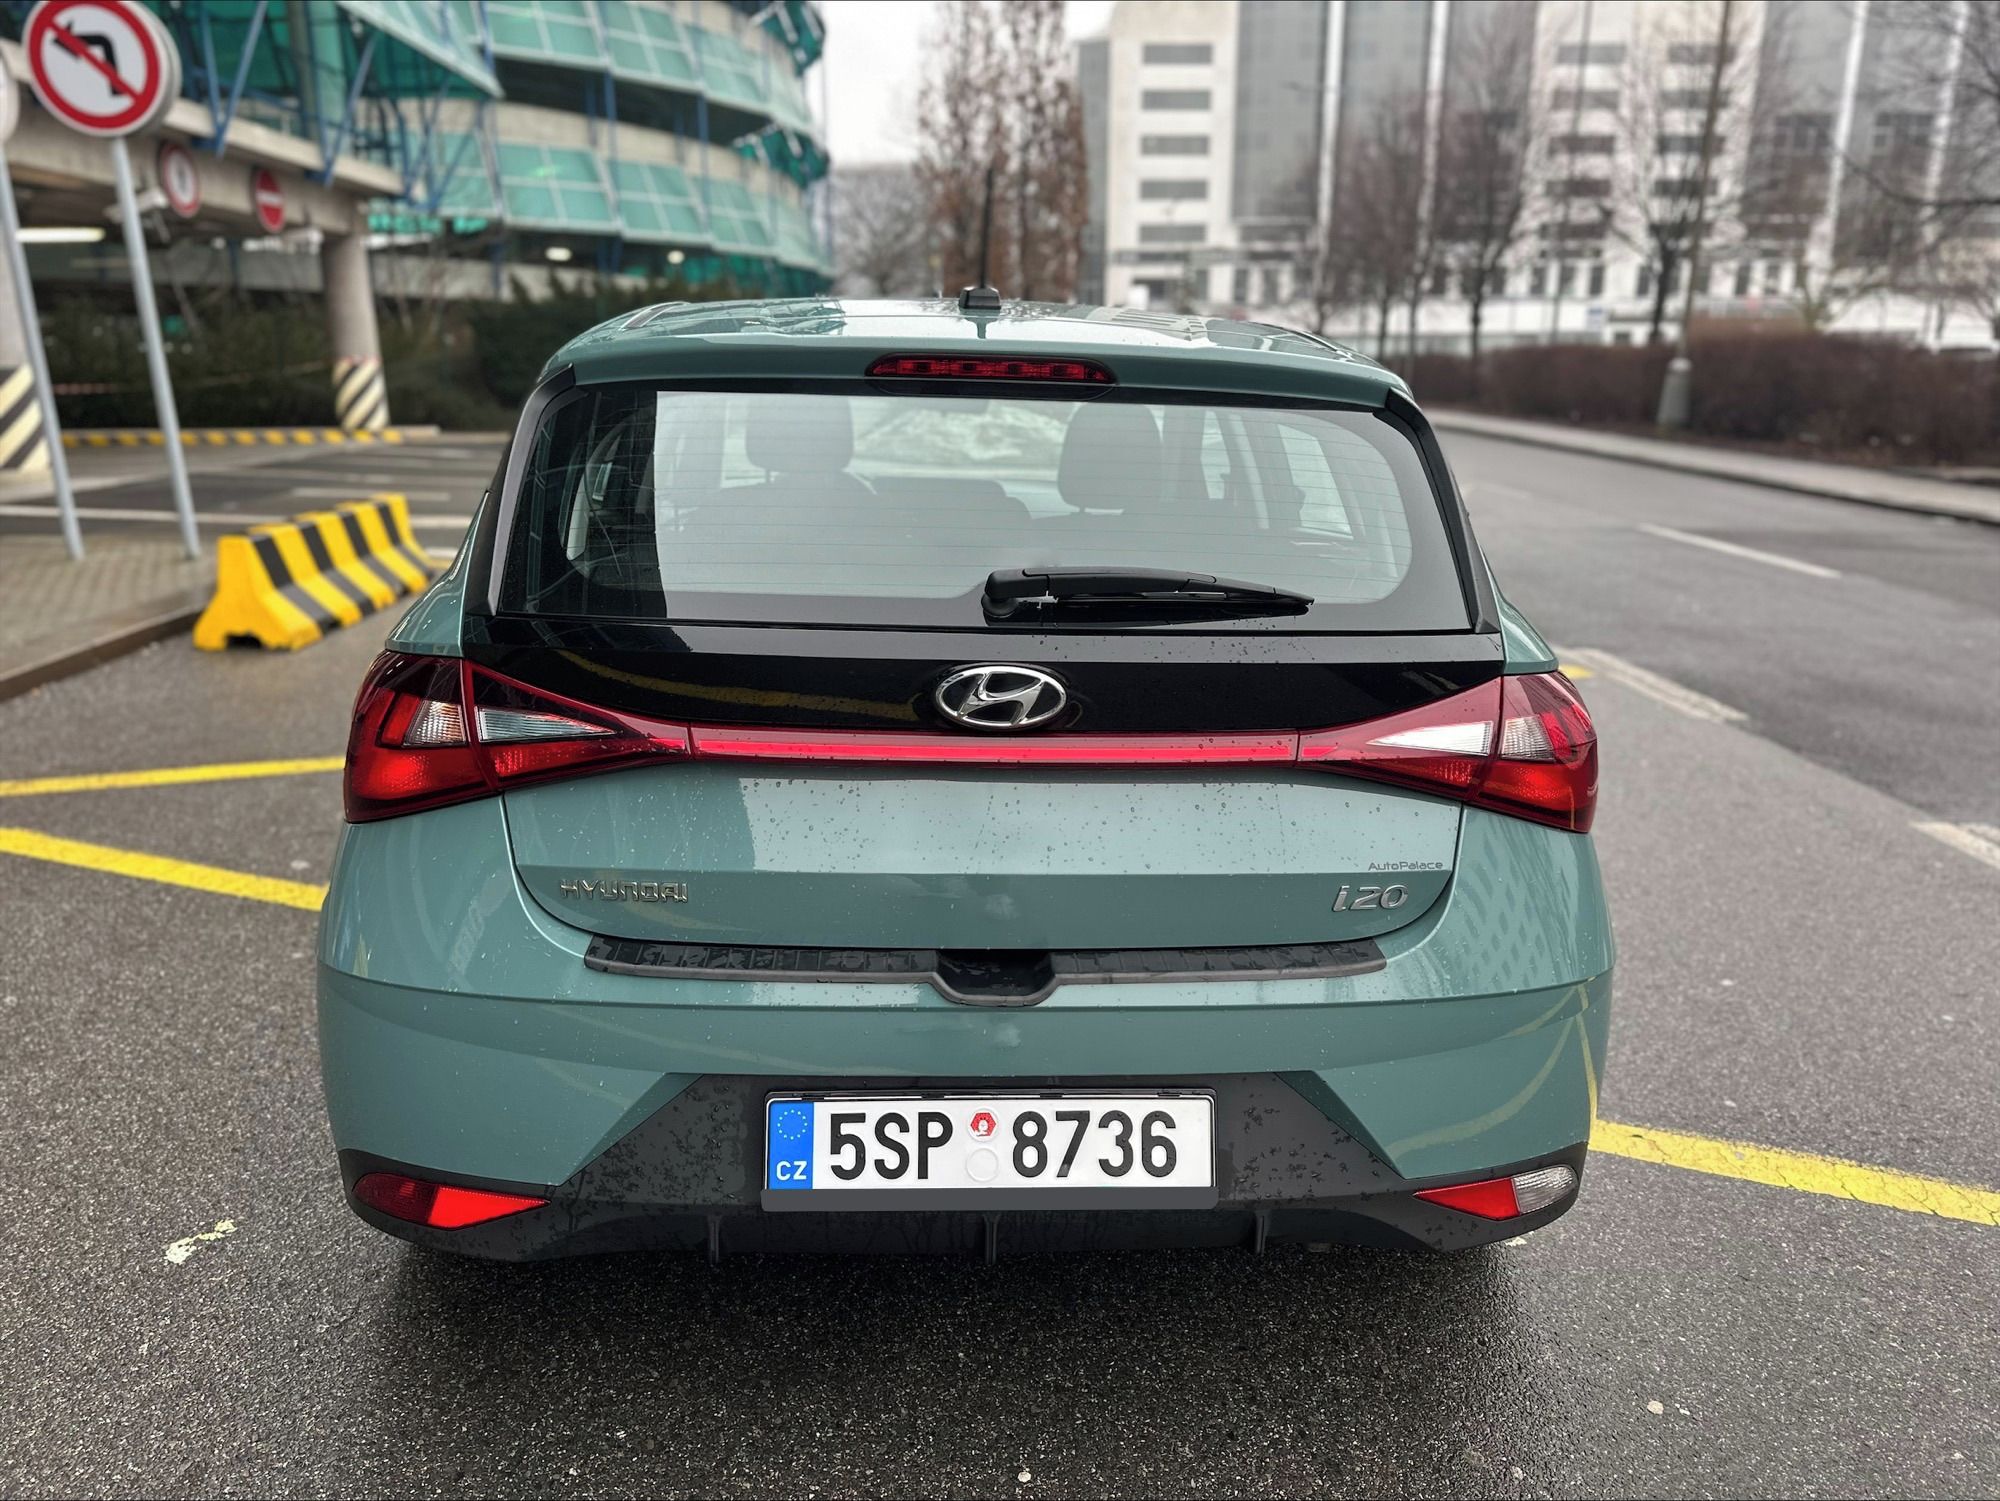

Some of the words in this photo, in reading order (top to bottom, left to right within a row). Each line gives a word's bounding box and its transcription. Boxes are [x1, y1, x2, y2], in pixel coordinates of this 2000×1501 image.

[1368, 861, 1443, 871] AutoPalace
[560, 879, 688, 902] HYUNDAI
[1333, 885, 1408, 912] i20
[830, 1112, 953, 1180] 5SP
[1012, 1110, 1176, 1178] 8736
[776, 1161, 806, 1180] CZ
